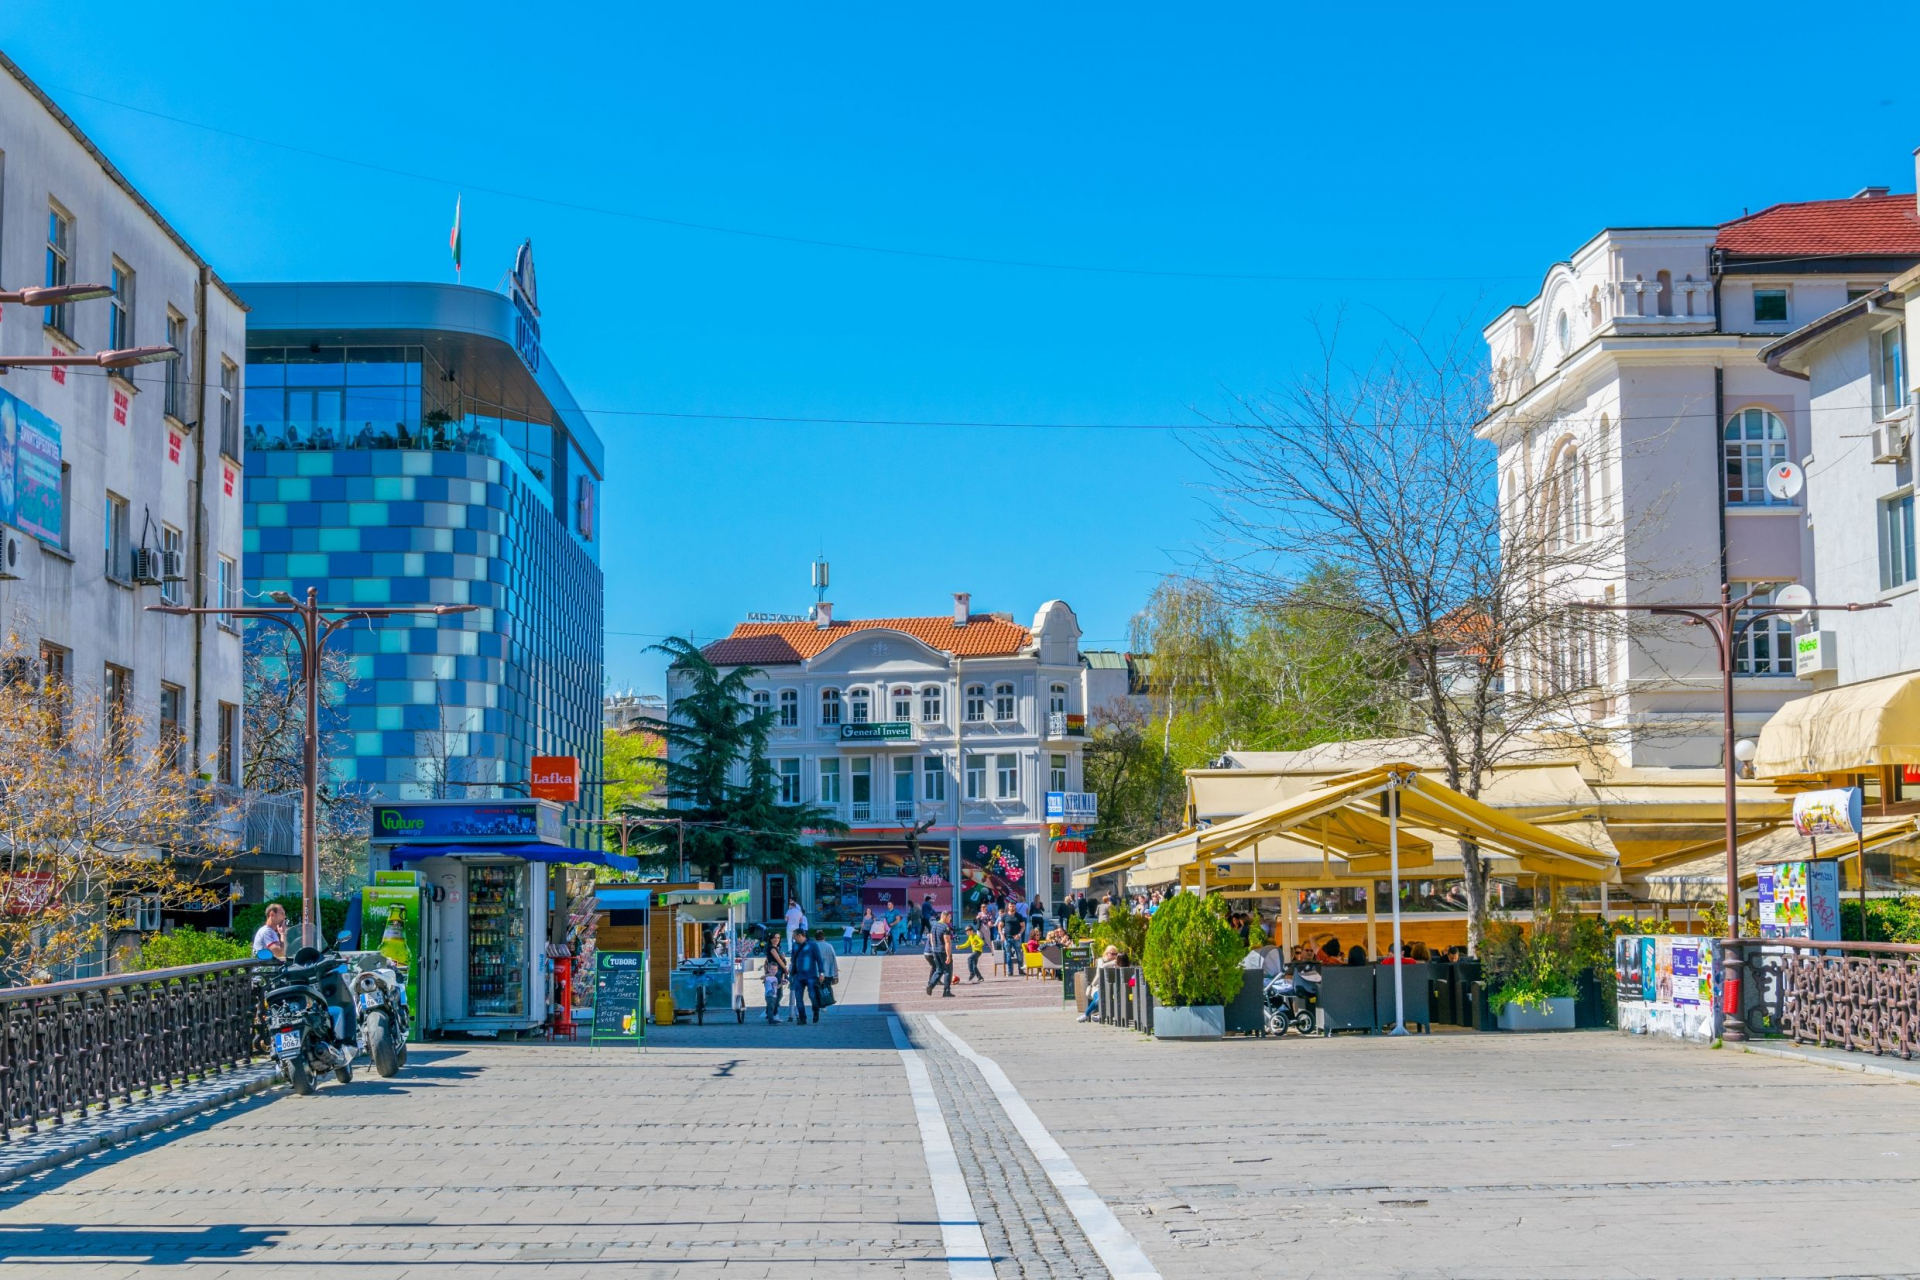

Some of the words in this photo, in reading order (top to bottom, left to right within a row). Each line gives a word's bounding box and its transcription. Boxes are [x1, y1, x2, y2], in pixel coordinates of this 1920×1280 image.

[842, 725, 881, 738] General
[882, 727, 909, 736] Invest
[533, 772, 573, 784] Lafka
[1066, 793, 1091, 810] STRUMA
[386, 816, 425, 830] future
[1056, 840, 1088, 853] GAMING
[921, 874, 943, 886] Raffy
[610, 958, 637, 966] TUBORG
[283, 1041, 299, 1049] 0067
